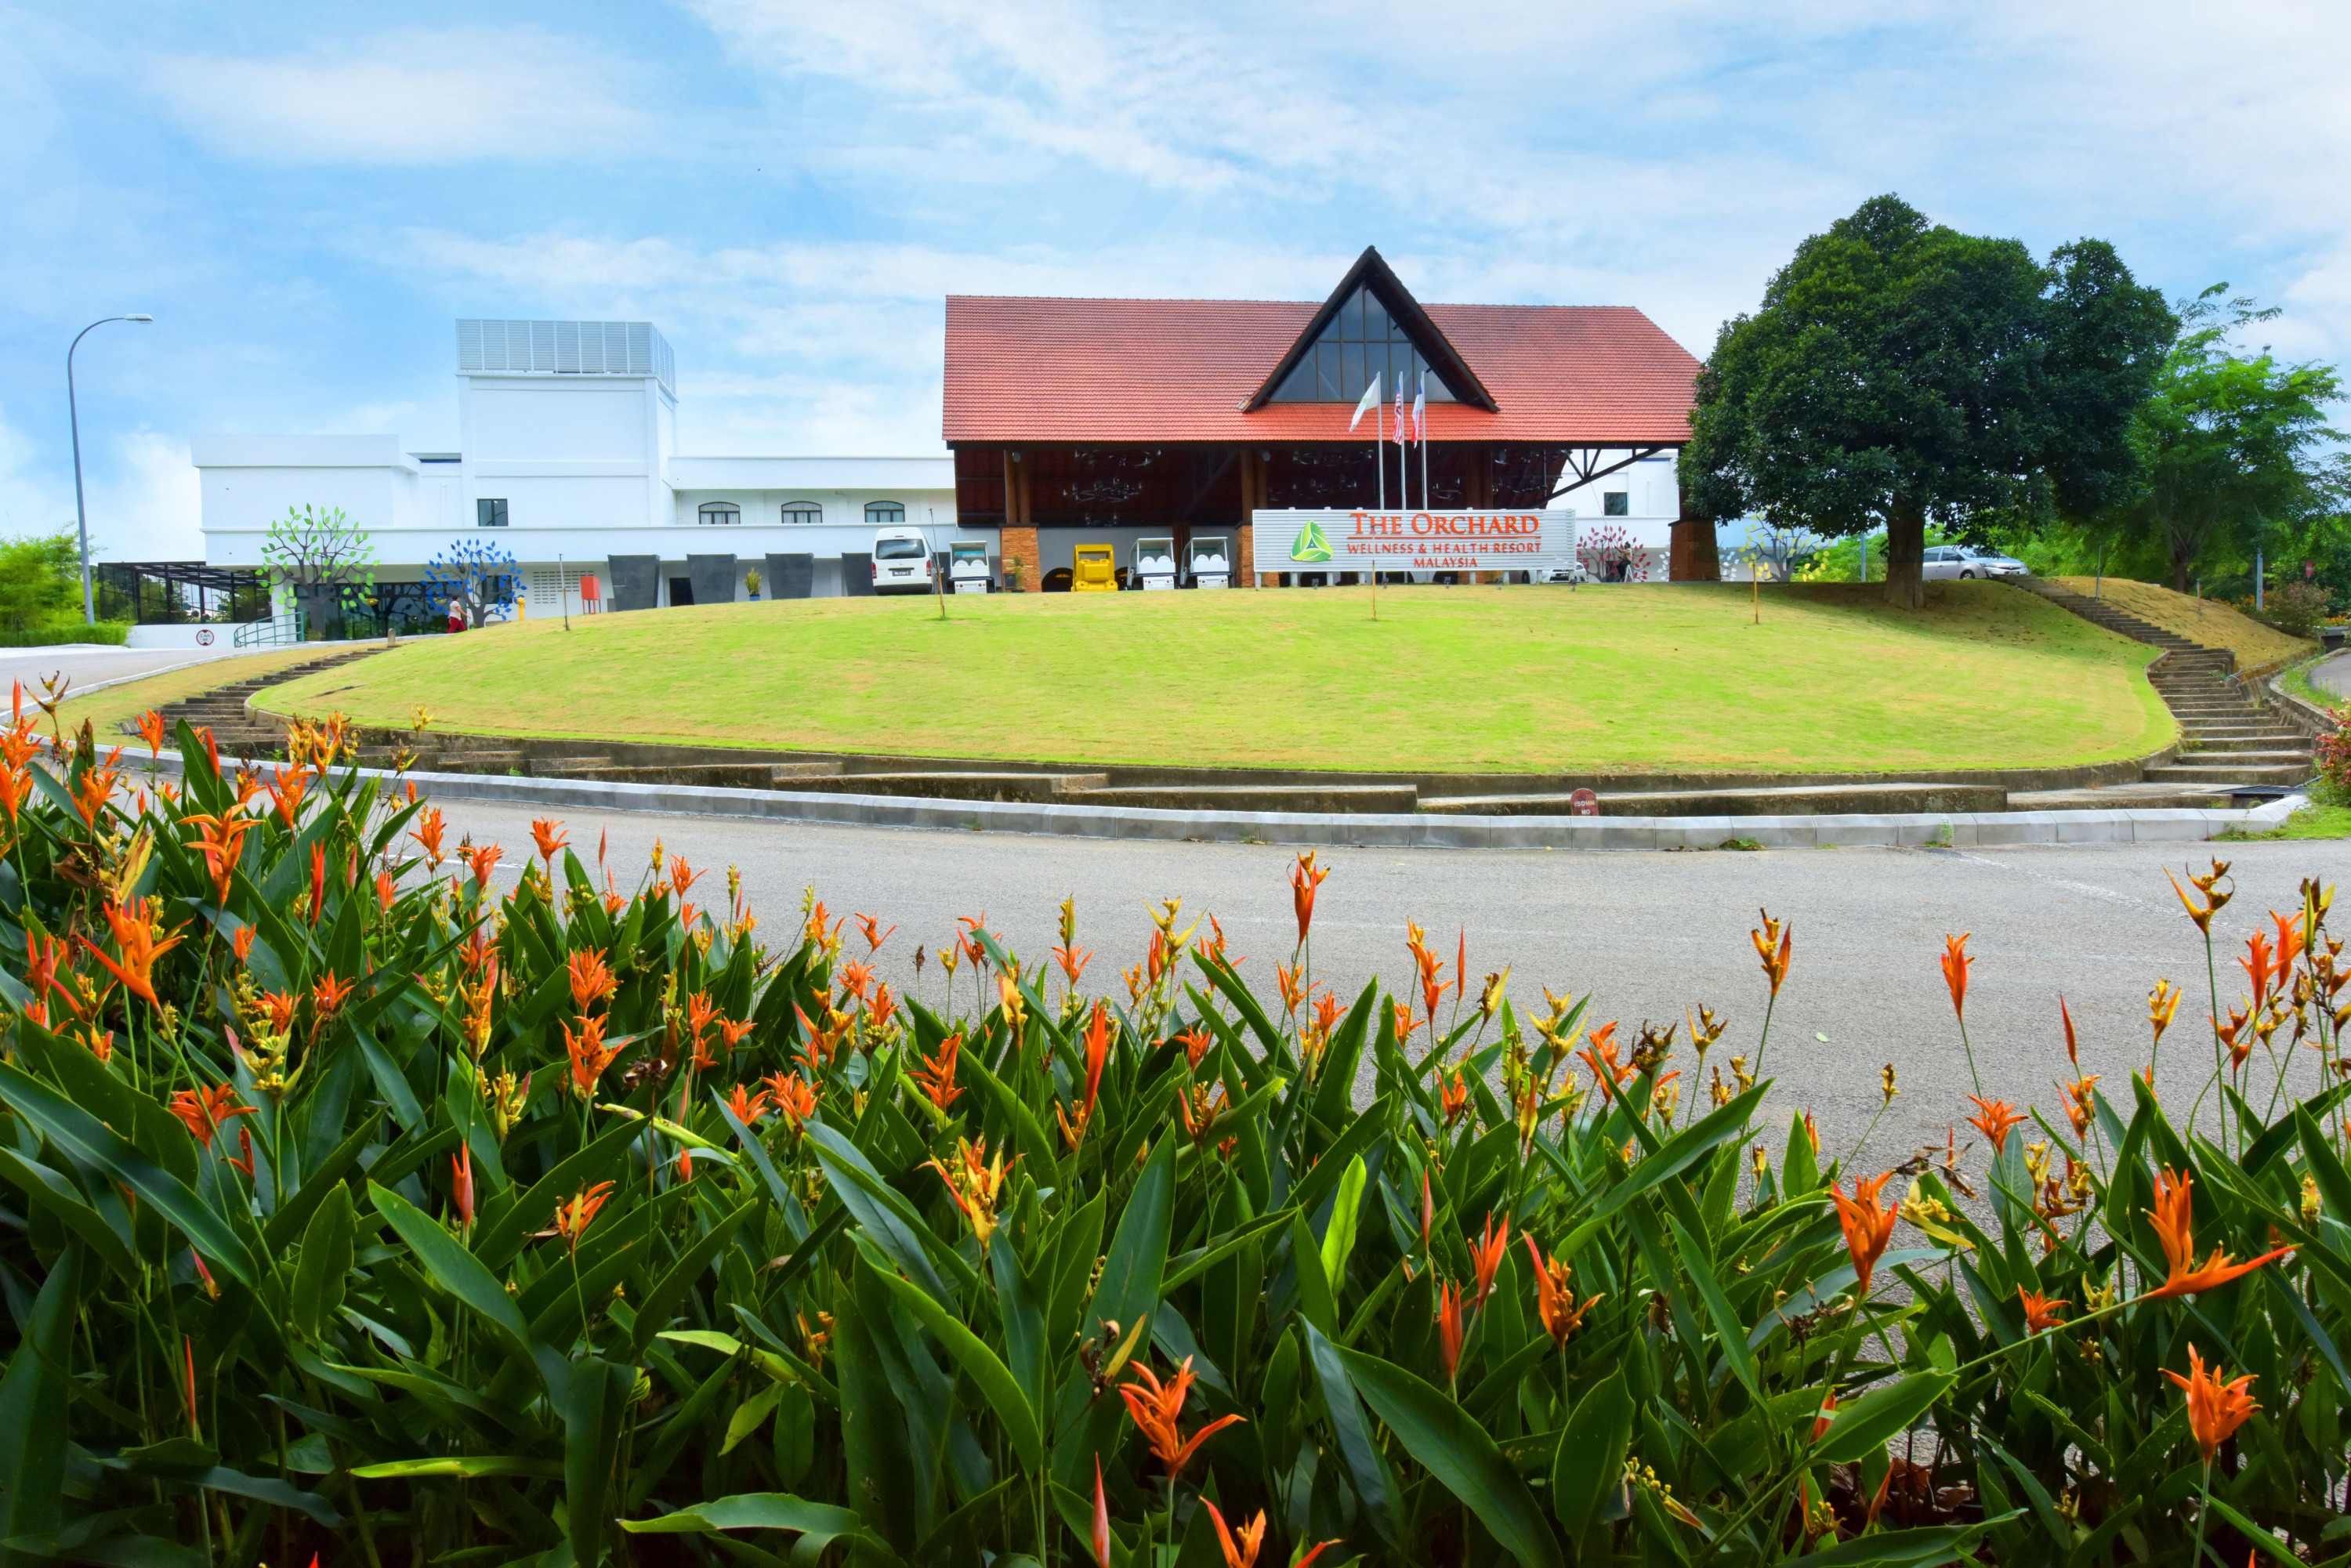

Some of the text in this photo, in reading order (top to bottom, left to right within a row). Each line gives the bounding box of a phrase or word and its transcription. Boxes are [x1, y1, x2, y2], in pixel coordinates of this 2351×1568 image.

[1349, 512, 1540, 535] THE ORCHARD
[1347, 542, 1541, 554] WELLNESS & HEALTH RESORT
[1414, 557, 1478, 568] MALAYSIA
